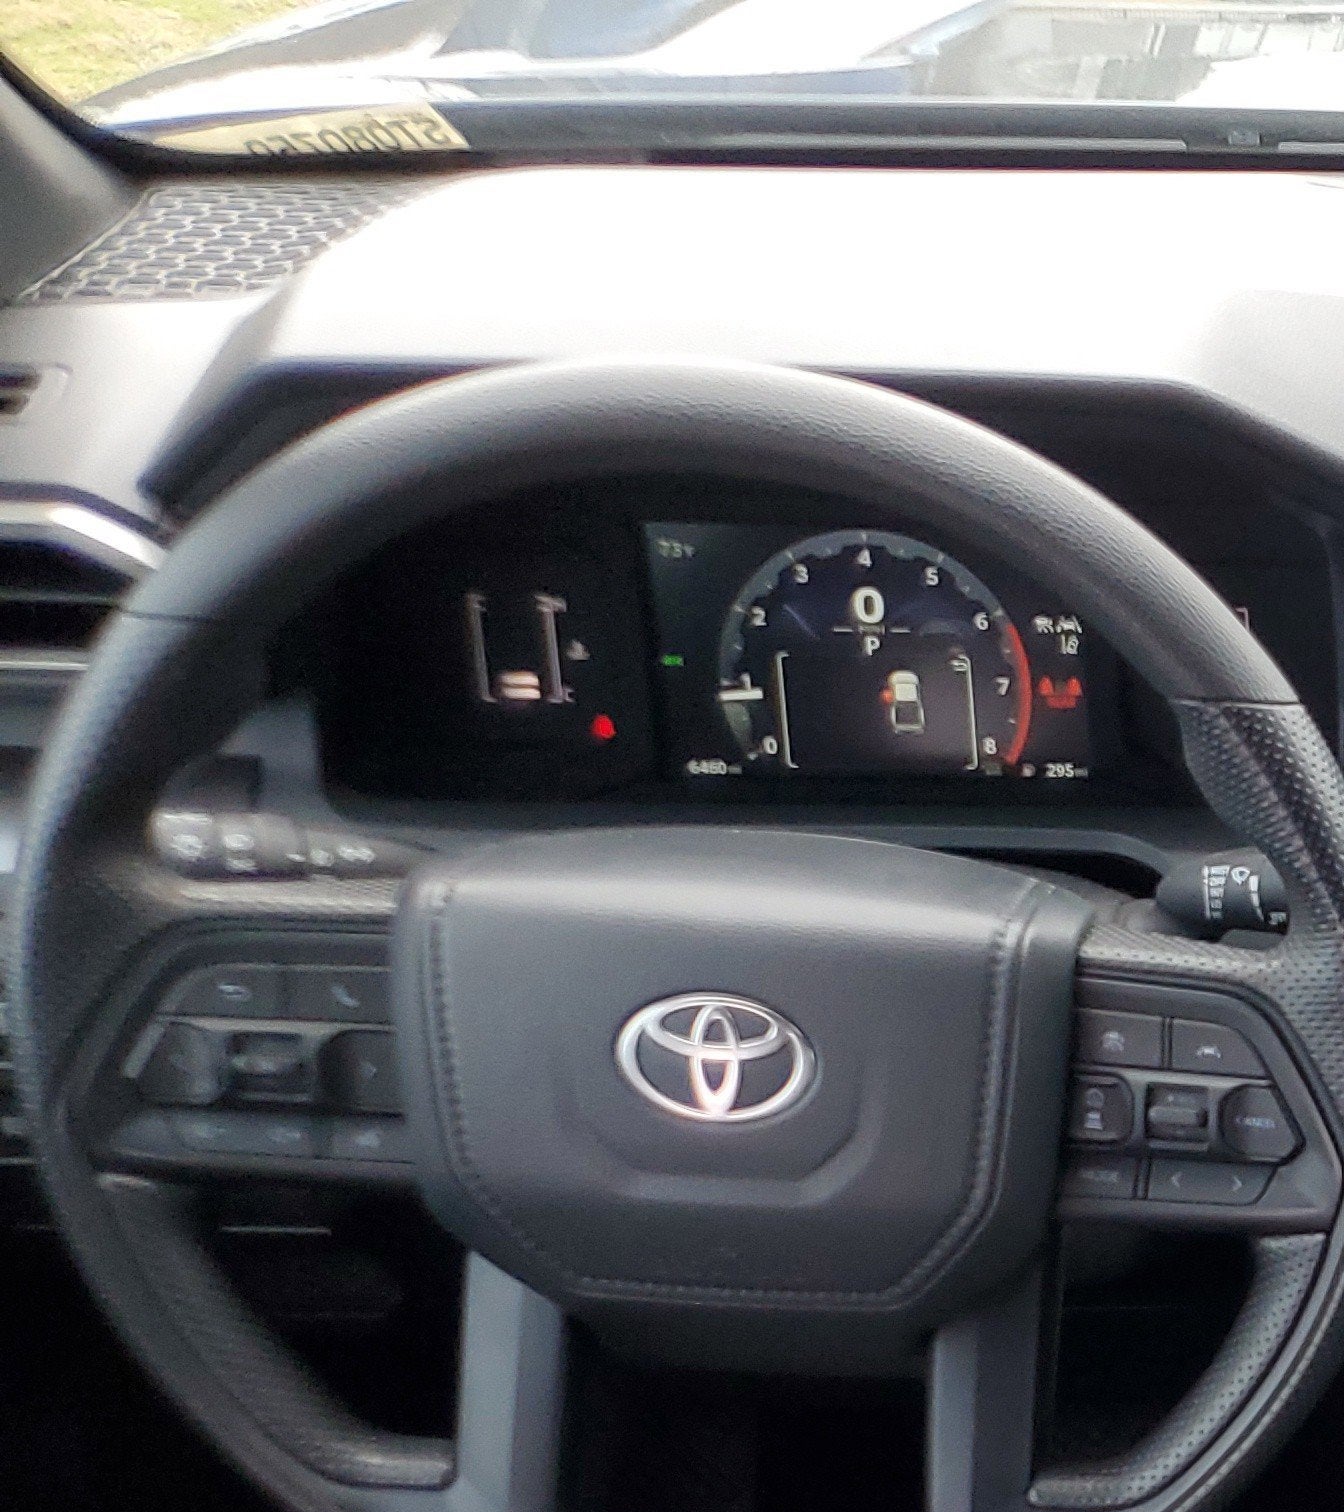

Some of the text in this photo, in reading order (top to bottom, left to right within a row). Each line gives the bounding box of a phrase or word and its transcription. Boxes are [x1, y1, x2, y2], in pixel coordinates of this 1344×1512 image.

[857, 549, 872, 568] 4
[795, 565, 809, 584] 3
[924, 565, 939, 586] 5
[851, 585, 885, 624] 0
[749, 605, 767, 627] 2
[974, 612, 989, 630] 6
[864, 635, 881, 656] P
[984, 737, 997, 755] 8
